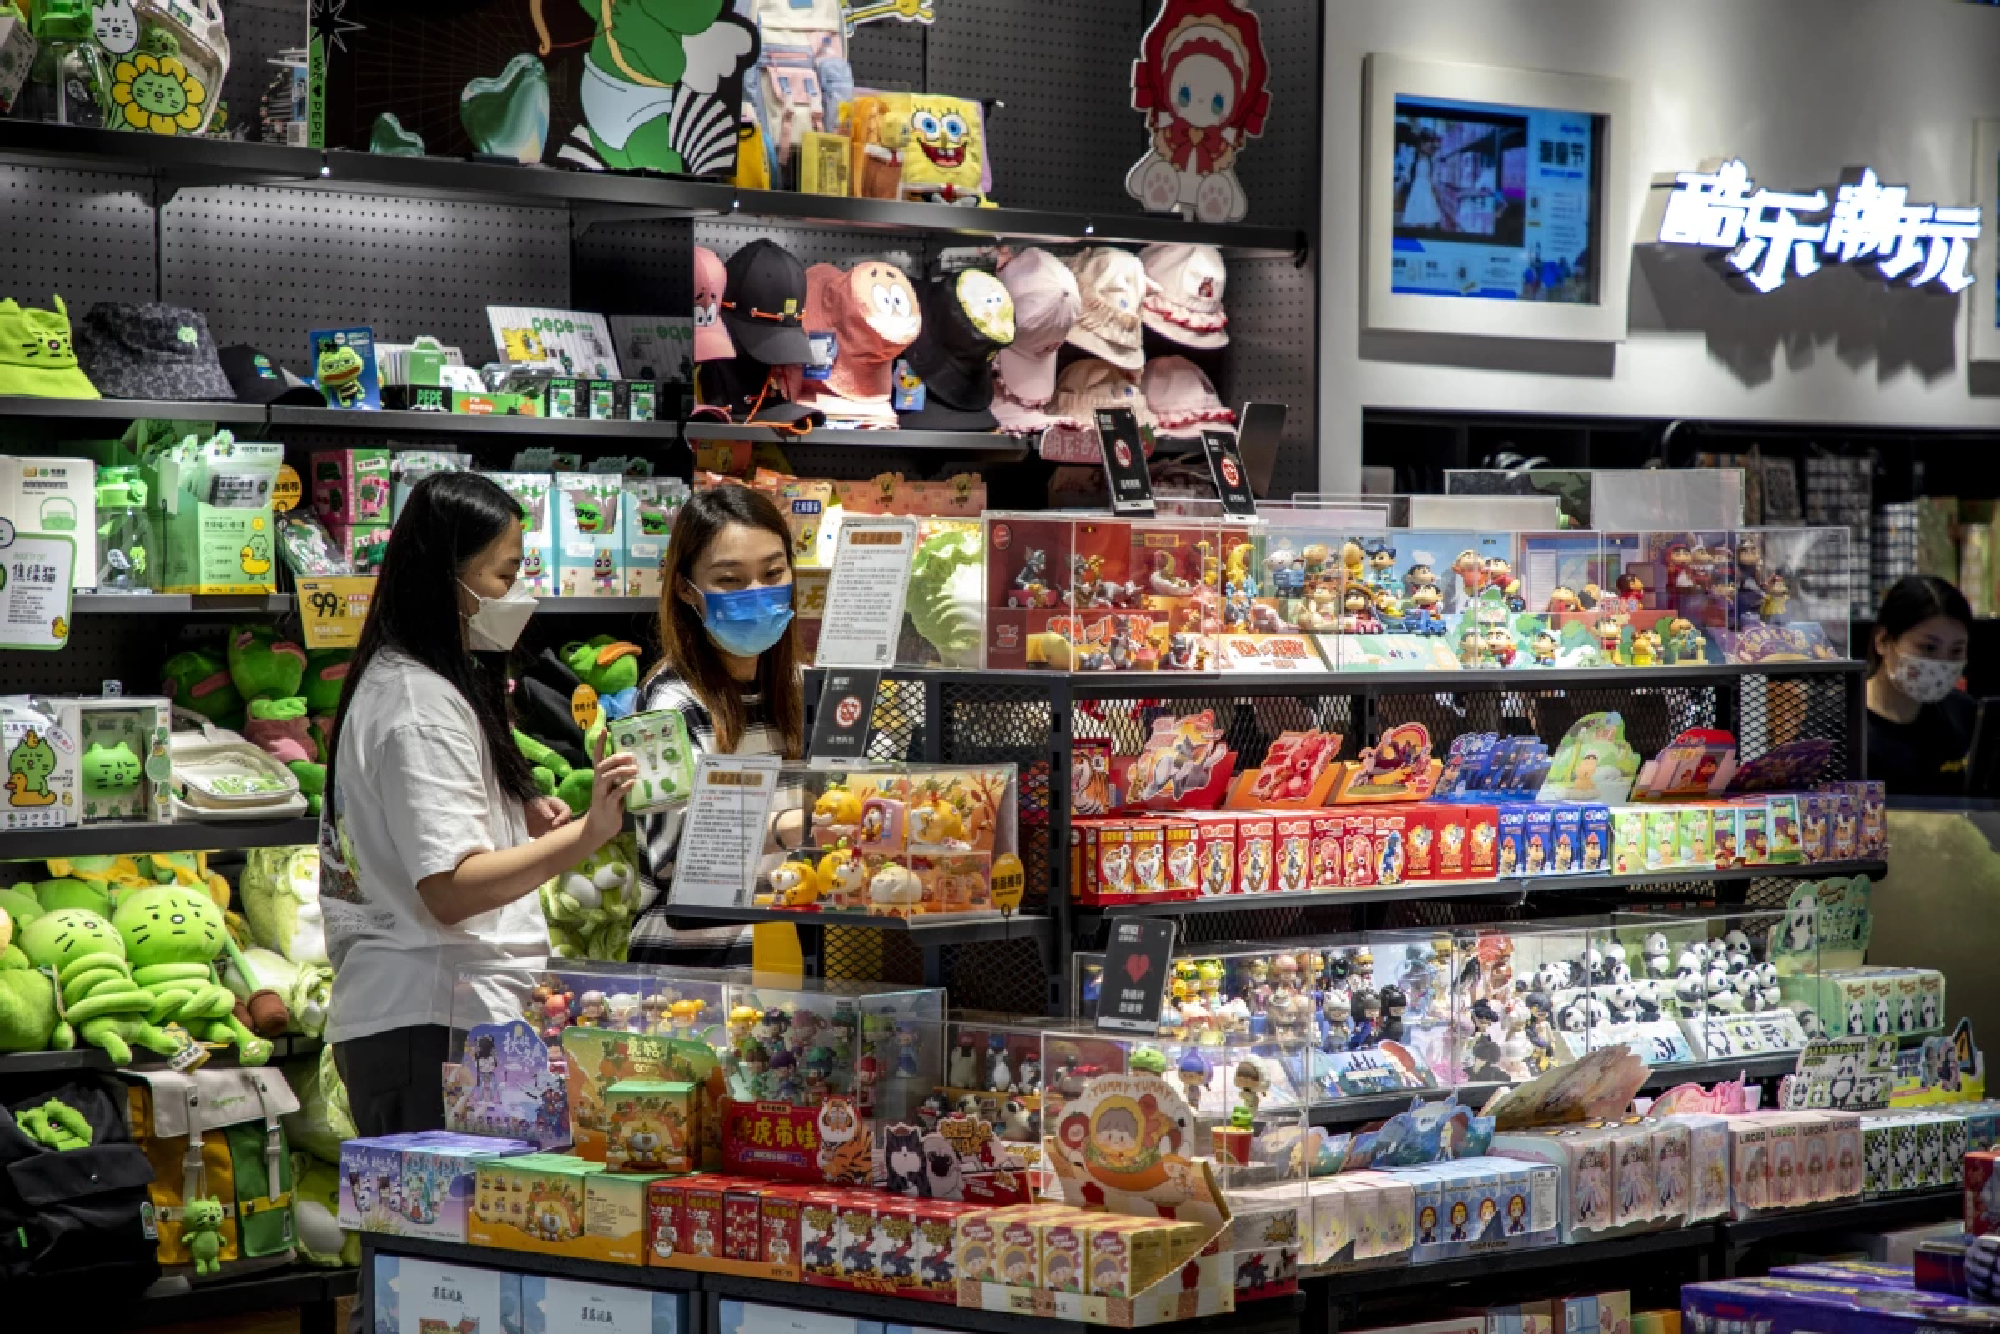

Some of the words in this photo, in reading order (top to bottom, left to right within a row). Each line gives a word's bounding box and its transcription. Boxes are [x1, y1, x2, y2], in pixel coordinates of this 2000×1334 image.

[1659, 157, 1982, 293] 酷乐潮玩
[531, 316, 575, 338] pepe
[313, 591, 338, 618] 99
[1091, 1081, 1131, 1099] YUMMY
[1133, 1081, 1173, 1102] YUMMY
